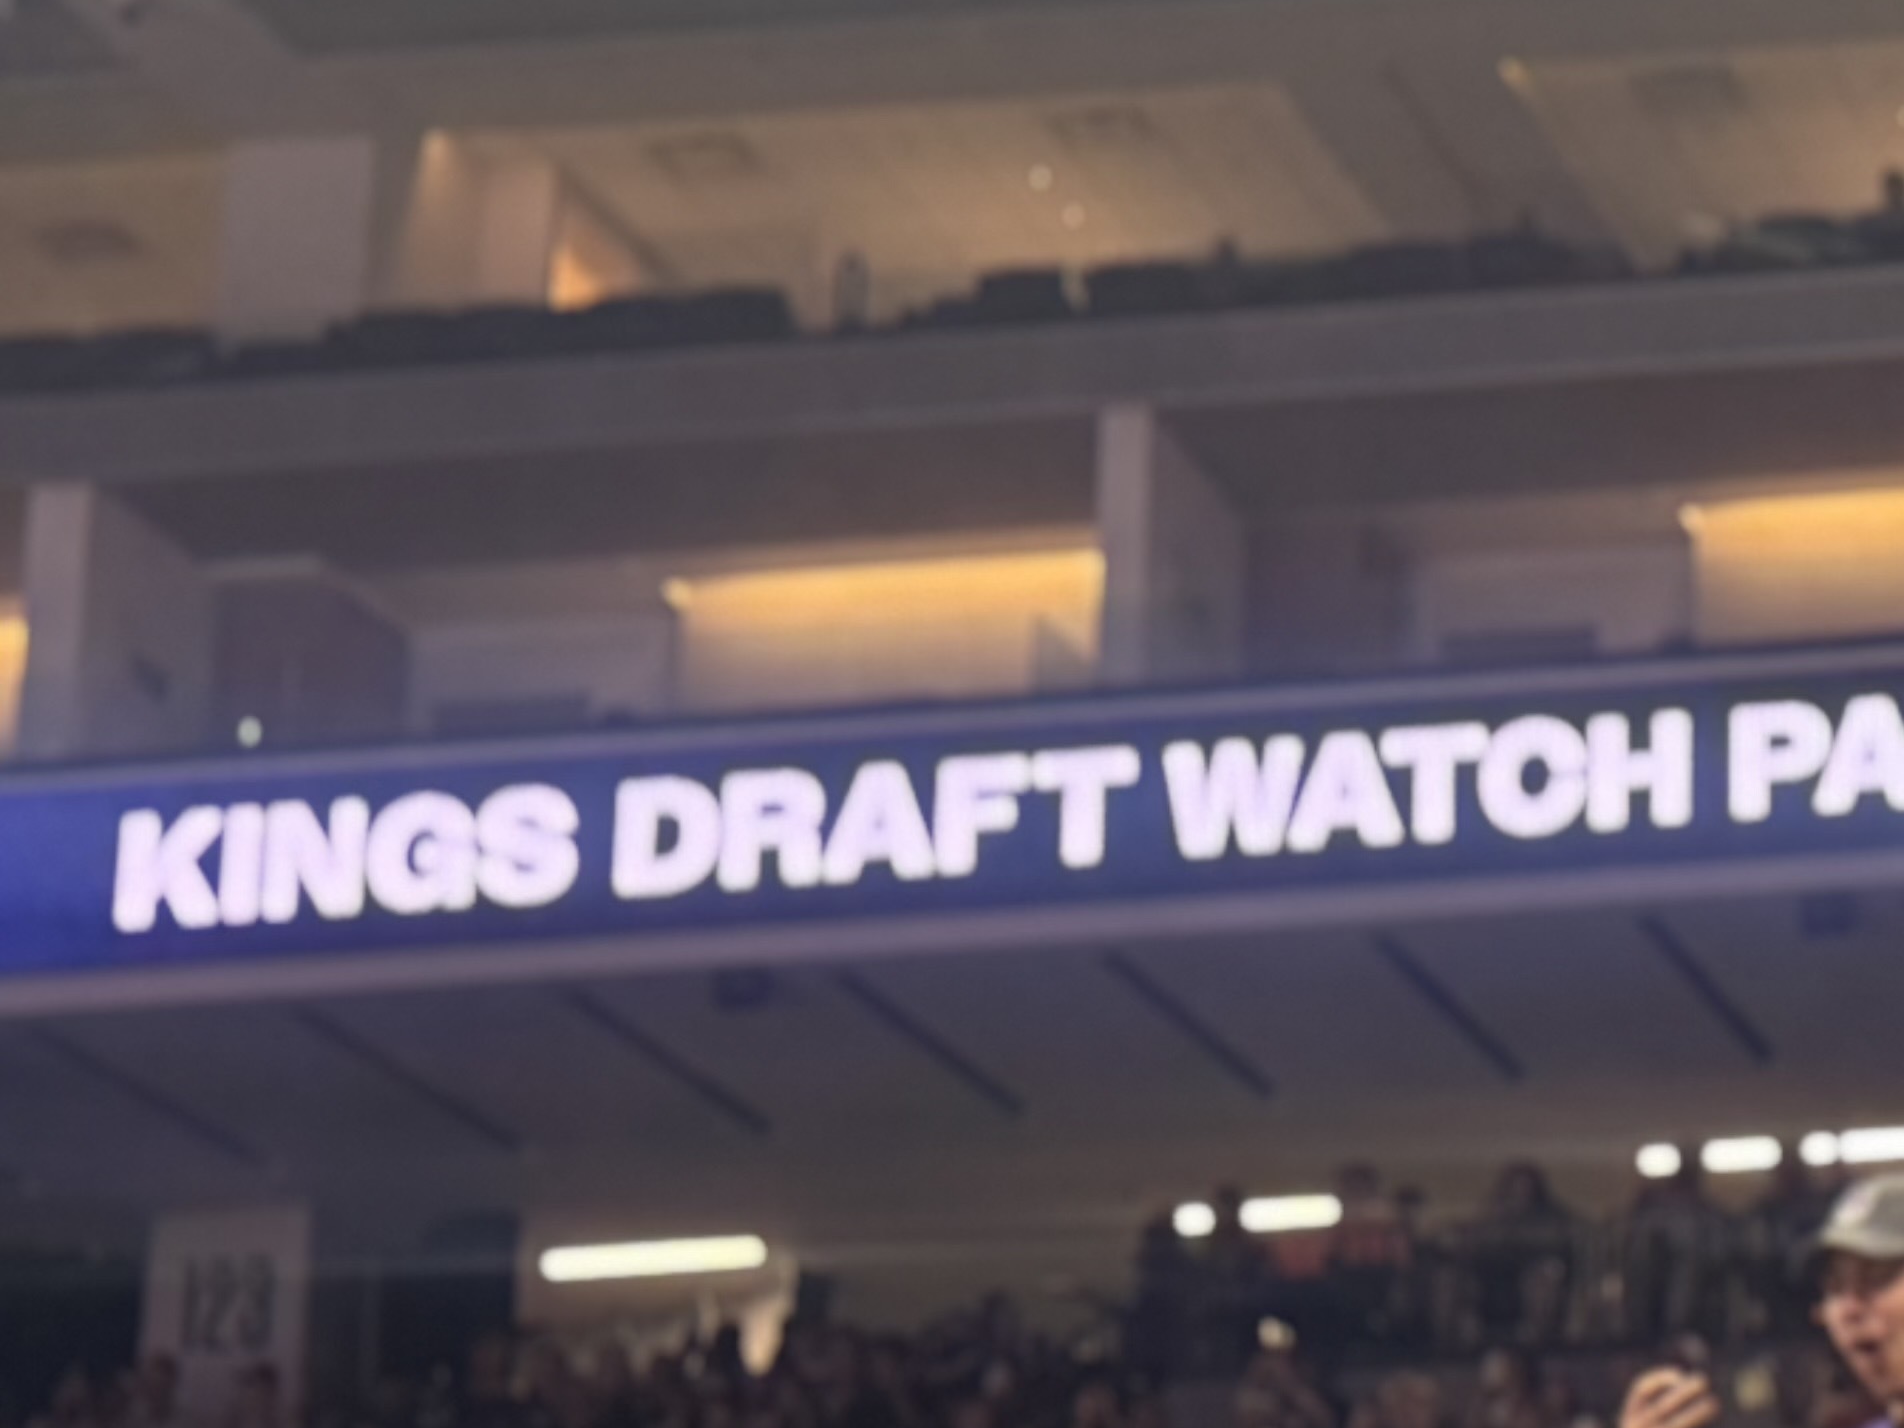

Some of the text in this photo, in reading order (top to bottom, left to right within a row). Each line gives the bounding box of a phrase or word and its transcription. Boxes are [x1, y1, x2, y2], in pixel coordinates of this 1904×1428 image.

[110, 781, 582, 934] KINGS
[609, 743, 1143, 900] DRAFT
[1161, 706, 1695, 861] WATCH
